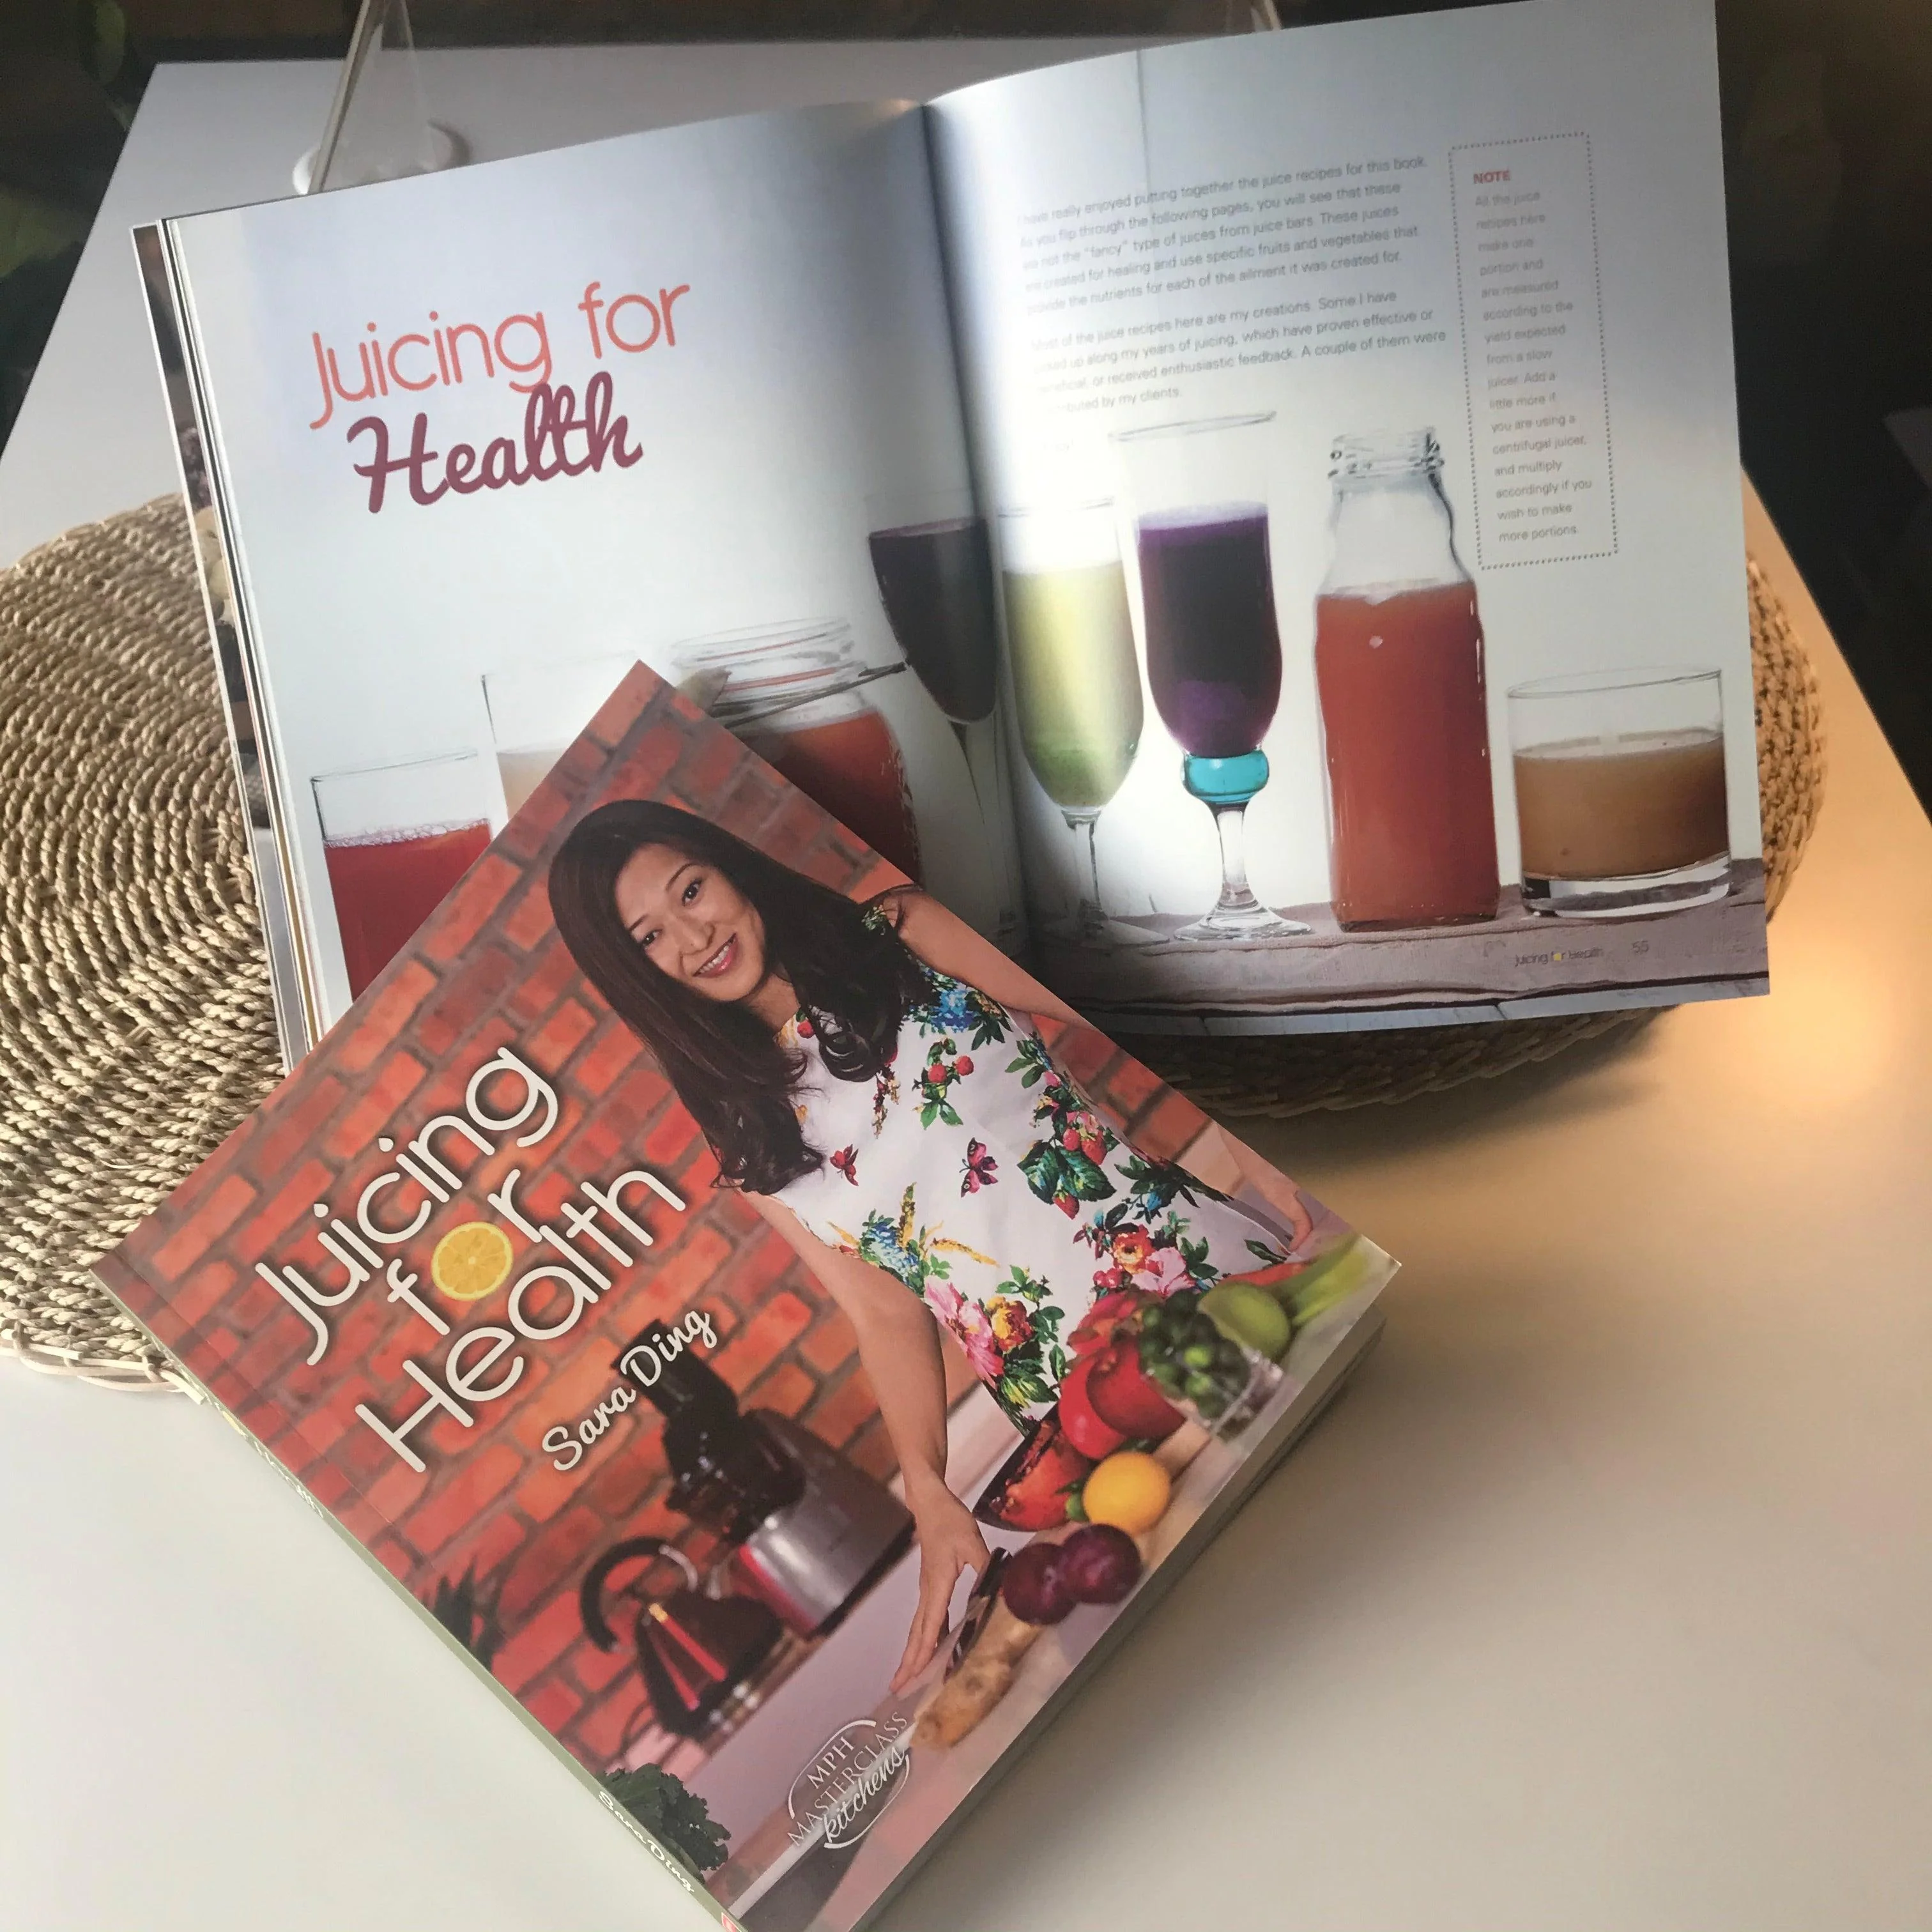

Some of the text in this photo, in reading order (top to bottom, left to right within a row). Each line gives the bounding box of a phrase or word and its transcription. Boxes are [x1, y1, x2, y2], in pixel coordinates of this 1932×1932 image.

[1473, 170, 1511, 184] NOTE
[1052, 205, 1080, 220] really
[1085, 195, 1131, 215] enjoyed
[1135, 188, 1177, 206] putting
[1181, 180, 1234, 199] together
[1239, 176, 1259, 189] the
[1262, 173, 1292, 188] juice
[1296, 165, 1342, 182] recipes
[1346, 162, 1363, 175] for
[1367, 159, 1390, 172] this
[1492, 194, 1510, 205] the
[1514, 192, 1540, 204] juice
[1036, 233, 1057, 247] you
[1080, 220, 1124, 236] through
[1128, 217, 1148, 229] the
[1152, 207, 1208, 224] following
[1212, 203, 1254, 217] pages,
[1257, 199, 1280, 211] you
[1284, 194, 1305, 206] will
[1309, 192, 1332, 203] see
[1337, 188, 1361, 199] that
[1365, 183, 1401, 195] these
[1521, 214, 1545, 226] here
[1041, 254, 1059, 266] not
[1062, 250, 1080, 263] the
[1133, 237, 1160, 251] type
[1163, 234, 1176, 247] of
[1179, 229, 1216, 246] juices
[1220, 225, 1250, 237] from
[1253, 221, 1282, 235] juice
[1320, 211, 1358, 225] These
[1362, 204, 1399, 222] juices
[1512, 238, 1534, 249] one
[1089, 268, 1103, 280] for
[1107, 262, 1151, 277] healing
[1154, 256, 1176, 270] and
[1180, 254, 1202, 266] use
[1207, 245, 1255, 264] specific
[1259, 241, 1290, 256] fruits
[1294, 237, 1317, 252] and
[1322, 230, 1390, 249] vegetables
[1393, 226, 1418, 238] that
[1480, 258, 1544, 276] portion and
[1069, 294, 1087, 307] the
[1091, 286, 1142, 303] nutrients
[1146, 282, 1162, 295] for
[1167, 278, 1195, 291] each
[1199, 273, 1211, 286] of
[1215, 272, 1235, 284] the
[1239, 264, 1285, 281] ailment
[1290, 263, 1298, 273] it
[1301, 260, 1328, 272] was
[1331, 253, 1379, 269] created
[1482, 280, 1558, 298] are measured
[1062, 334, 1073, 346] of
[1076, 331, 1094, 342] the
[1098, 326, 1124, 341] juice
[1128, 319, 1172, 337] recipes
[1175, 317, 1202, 328] here
[1207, 312, 1225, 323] are
[1230, 309, 1249, 322] my
[1318, 296, 1356, 310] Some
[1367, 291, 1397, 303] have
[1483, 301, 1574, 321] according to the
[1087, 351, 1118, 367] along
[1121, 349, 1138, 362] my
[1143, 342, 1175, 358] years
[1179, 340, 1191, 351] of
[1194, 333, 1238, 351] juicing,
[1243, 327, 1279, 342] which
[1283, 325, 1312, 337] have
[1316, 319, 1359, 336] proven
[1363, 312, 1417, 327] effective
[1420, 309, 1434, 321] or
[1484, 324, 1566, 343] yield expected
[310, 282, 690, 429] Juicing for
[1092, 376, 1103, 386] or
[1107, 367, 1157, 385] received
[1161, 356, 1234, 376] enthusiastic
[1301, 344, 1311, 357] A
[1314, 341, 1356, 356] couple
[1360, 337, 1373, 351] of
[1377, 334, 1410, 349] them
[1414, 330, 1446, 344] were
[1487, 350, 1552, 365] from a slow
[1524, 372, 1546, 383] Add
[1549, 372, 1556, 381] a
[1101, 395, 1115, 408] by
[1119, 395, 1136, 404] my
[1489, 392, 1556, 409] little more if
[1491, 415, 1575, 433] you are using a
[347, 371, 643, 513] Health
[1492, 435, 1587, 455] centrifugal juicer,
[1494, 459, 1562, 476] and multiply
[1496, 479, 1592, 499] accordingly if you
[1498, 503, 1572, 520] wish to make
[1499, 530, 1528, 542] more
[1632, 940, 1649, 954] 55
[256, 1047, 558, 1366] Juicing
[355, 1170, 686, 1473] Health
[542, 1311, 717, 1471] Sara Ding
[807, 1736, 854, 1789] MPH
[787, 1712, 907, 1846] MASTERCLASS
[823, 1746, 905, 1843] kitchens
[598, 1791, 647, 1844] Sara
